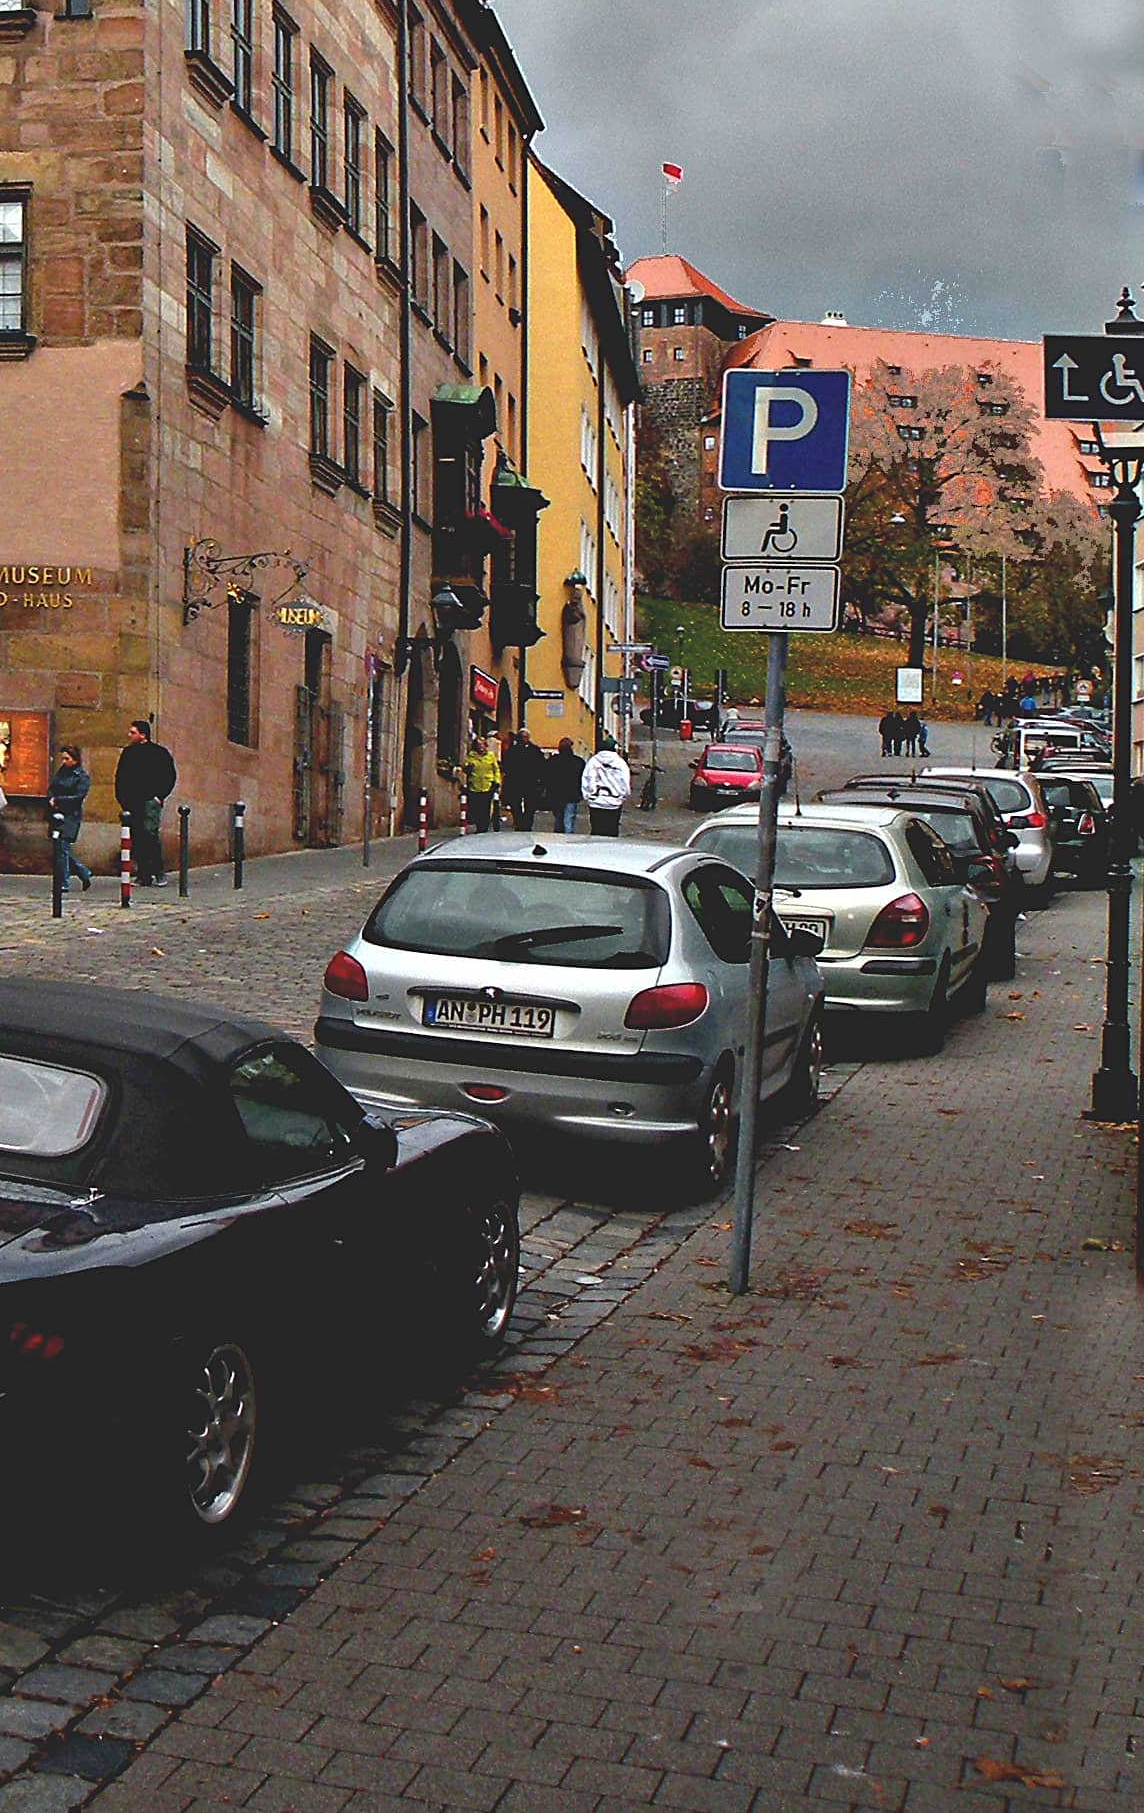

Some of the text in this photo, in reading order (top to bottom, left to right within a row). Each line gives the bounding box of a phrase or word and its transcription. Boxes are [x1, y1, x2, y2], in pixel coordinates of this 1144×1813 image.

[751, 387, 818, 475] P
[744, 575, 811, 595] Mo-Fr
[741, 601, 751, 617] 8
[779, 601, 796, 617] 18
[802, 602, 811, 617] h
[437, 1000, 465, 1021] AN
[478, 1003, 506, 1025] PH
[510, 1006, 550, 1029] 119
